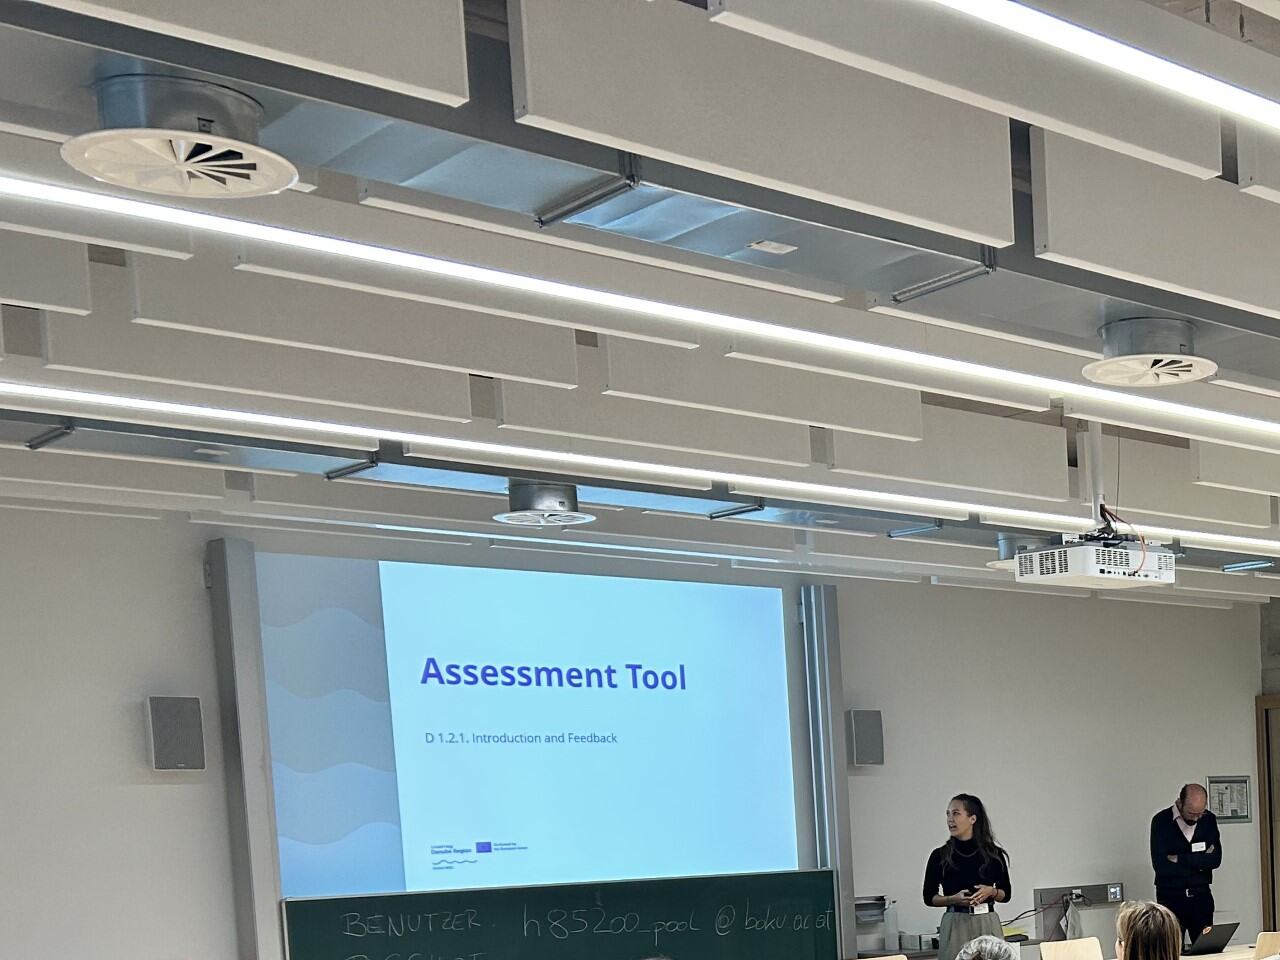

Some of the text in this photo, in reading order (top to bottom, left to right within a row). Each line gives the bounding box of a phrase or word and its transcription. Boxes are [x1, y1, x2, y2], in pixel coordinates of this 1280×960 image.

[420, 656, 686, 690] Assessment Tool
[425, 732, 618, 744] D 1.2.1. Introduction and Feedback
[341, 909, 481, 937] BENUTZER
